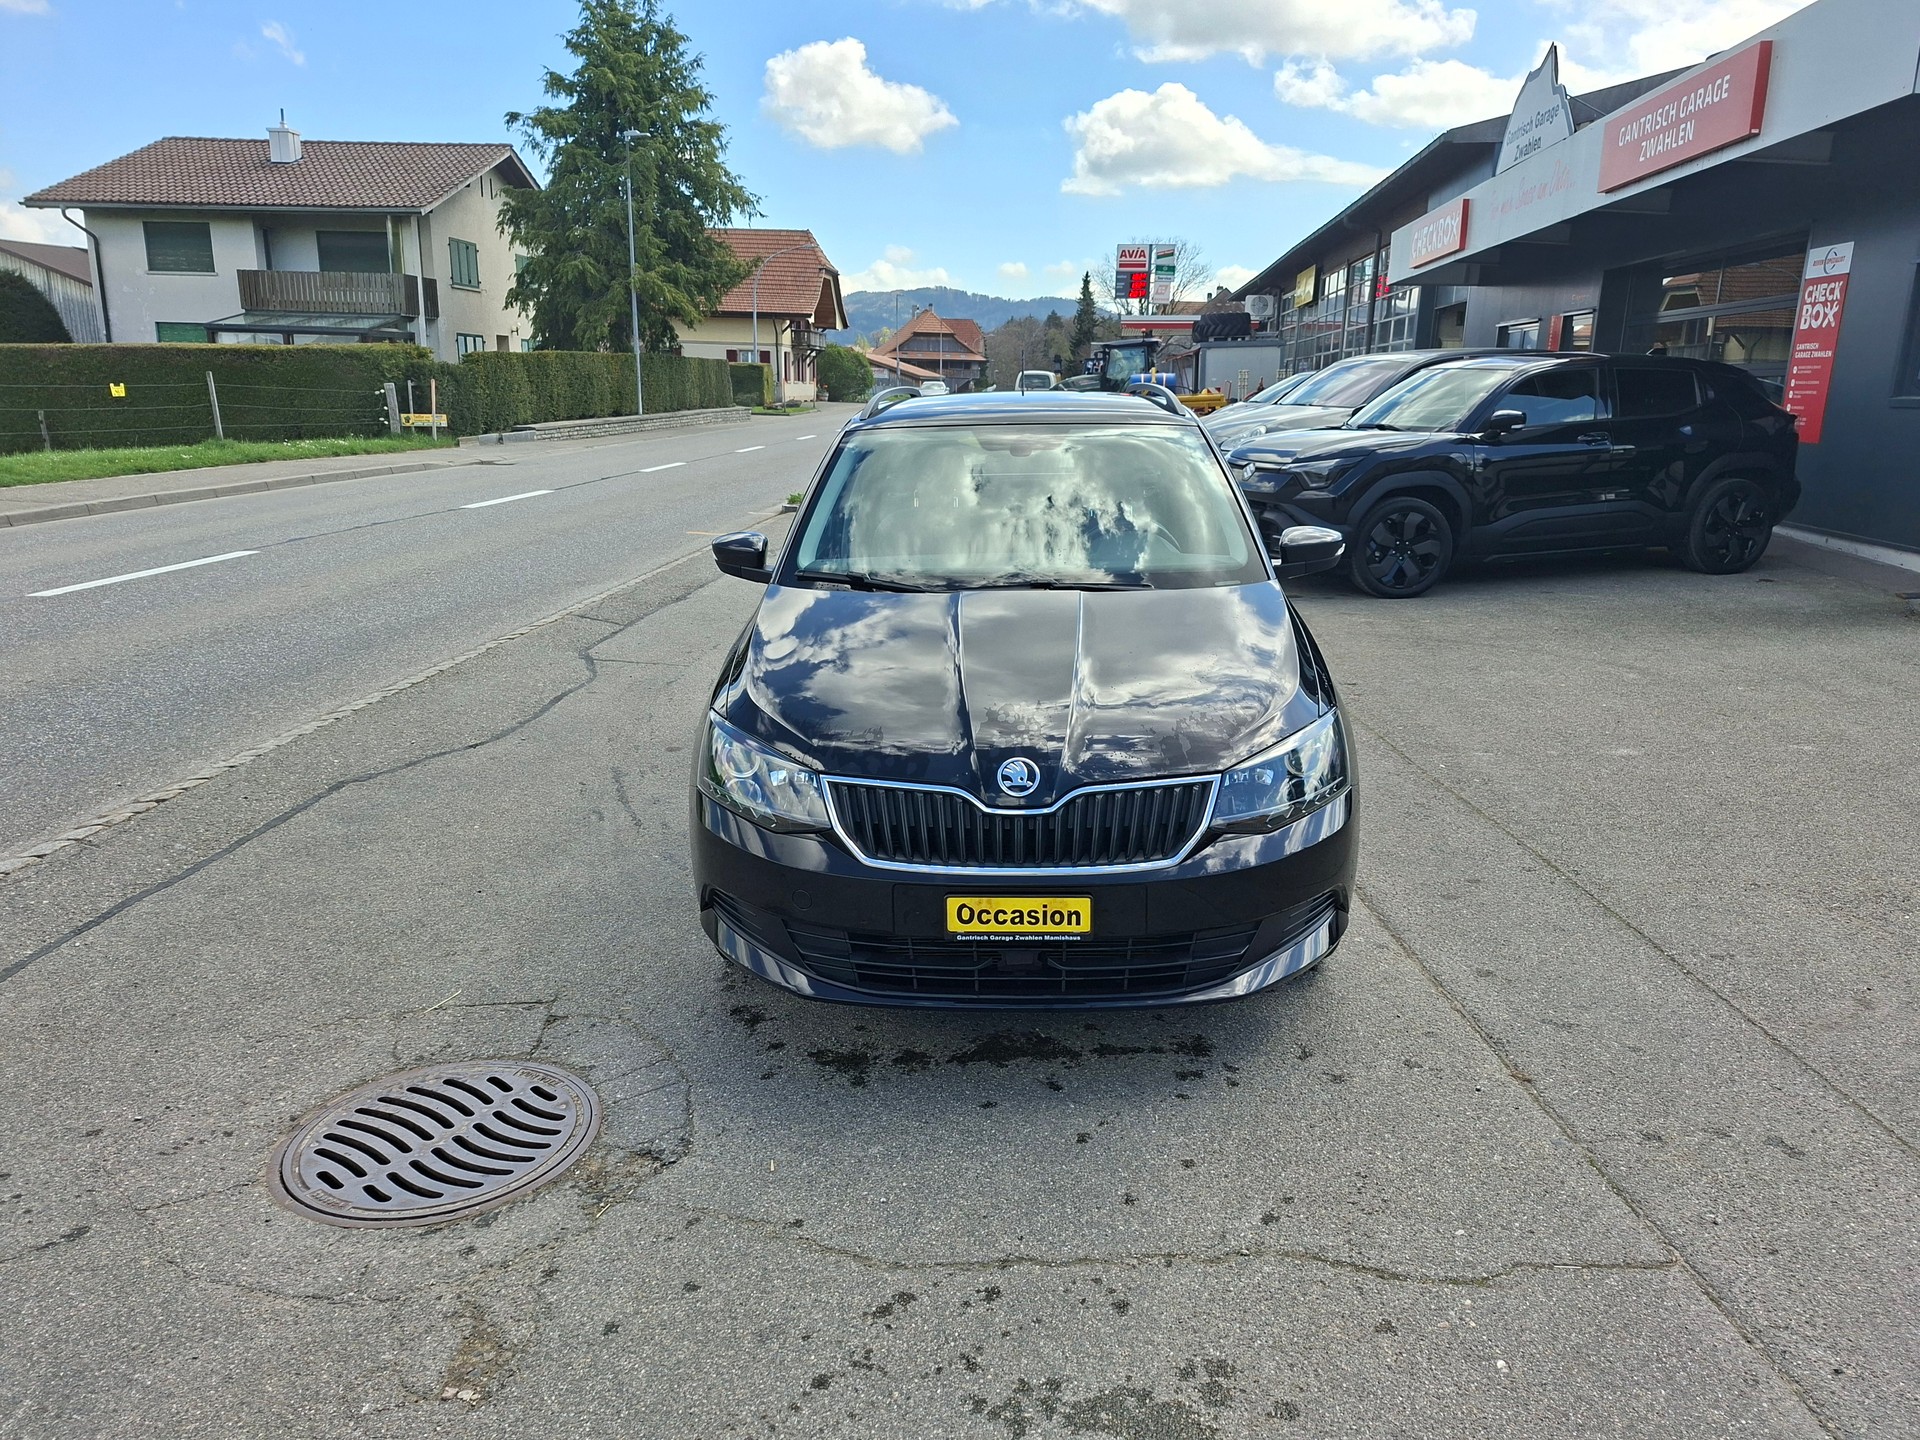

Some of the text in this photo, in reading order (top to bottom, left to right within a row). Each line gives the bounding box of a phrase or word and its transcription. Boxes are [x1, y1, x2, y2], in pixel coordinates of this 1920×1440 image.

[1618, 74, 1731, 147] GANTRISCH GARAGE
[1506, 103, 1560, 146] Gantrisch Garage
[1513, 136, 1542, 162] Zwahlen
[1639, 119, 1695, 162] ZWAHLEN
[1411, 209, 1461, 259] CHECKBOX
[1120, 247, 1146, 259] AVIA
[1804, 281, 1843, 303] CHECK
[1800, 301, 1839, 330] BOX
[1794, 350, 1833, 359] GARAGE ZWAHLEN
[1796, 342, 1820, 351] GANTRISCH
[956, 903, 1081, 926] Occasion
